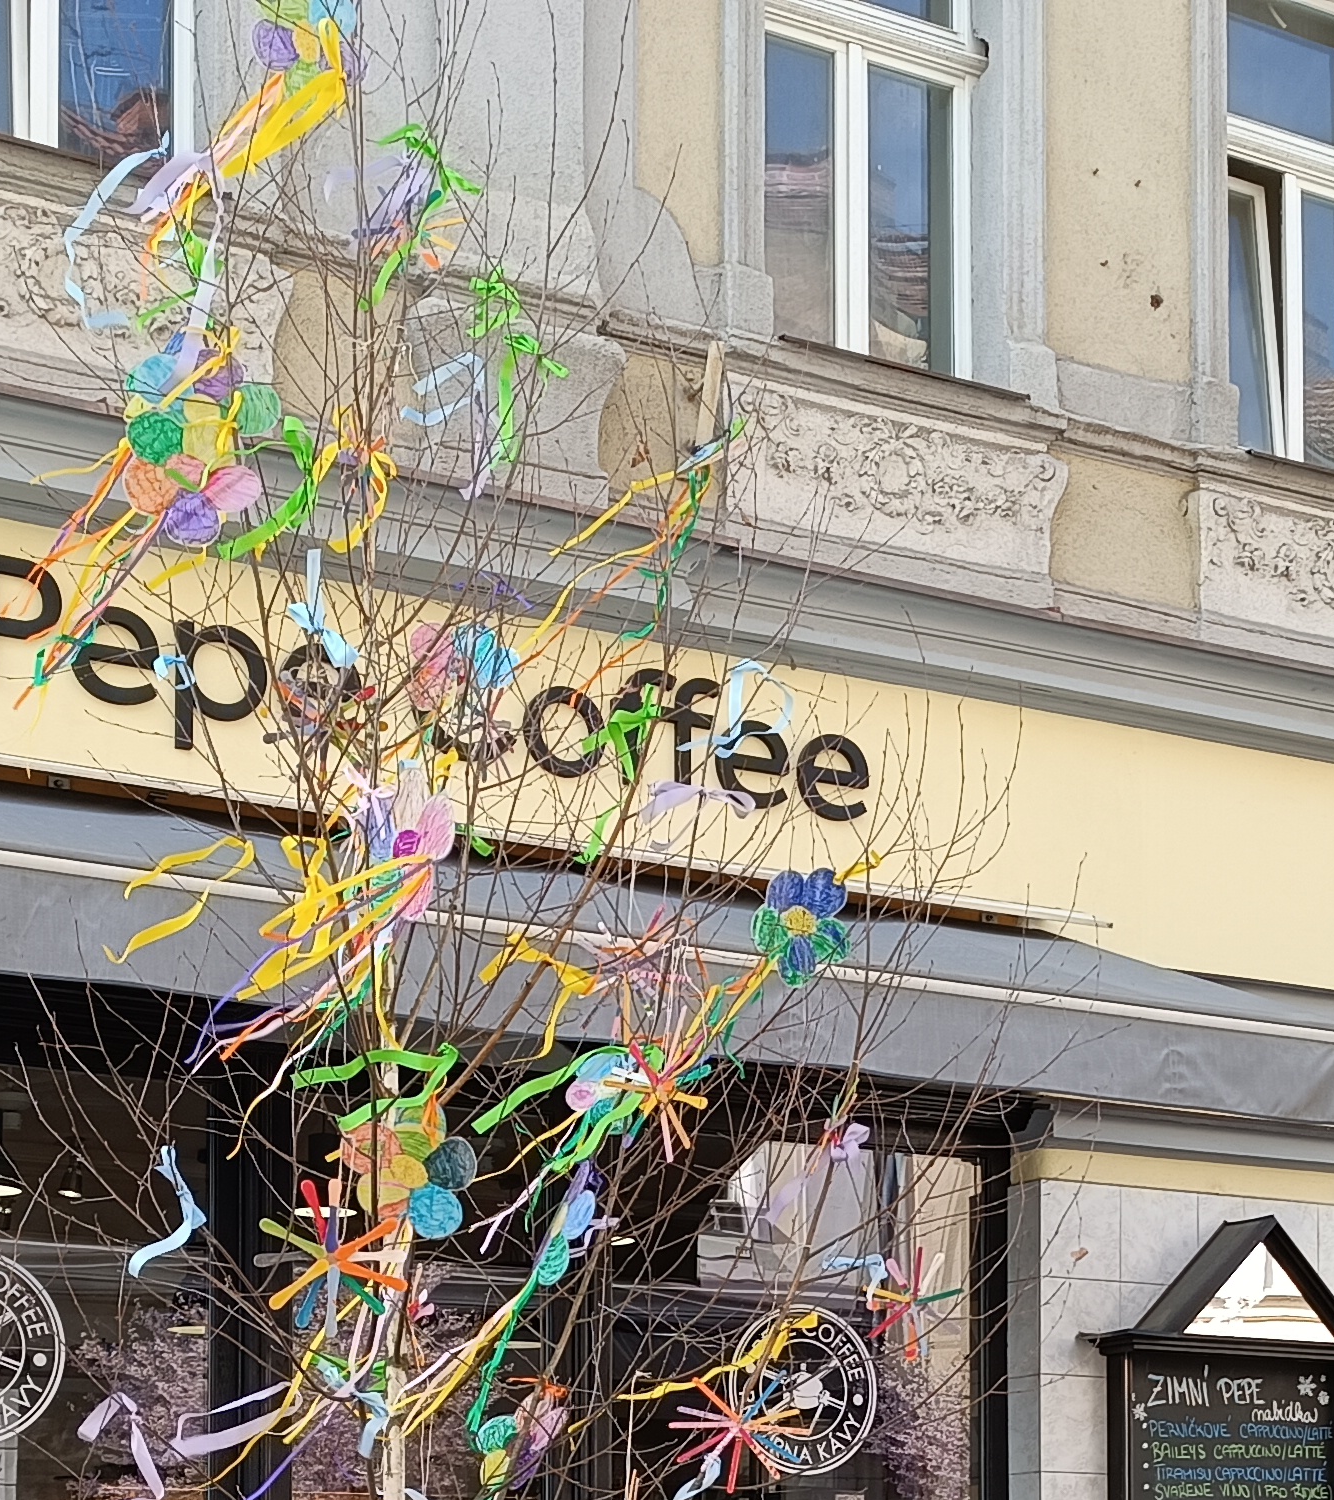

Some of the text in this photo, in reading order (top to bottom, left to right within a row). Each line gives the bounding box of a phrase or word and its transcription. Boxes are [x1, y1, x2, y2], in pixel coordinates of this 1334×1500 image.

[1146, 1364, 1266, 1408] ZIMNÍ PEPE
[1251, 1399, 1319, 1424] nabídka
[816, 1412, 861, 1462] KÁVY
[1151, 1441, 1207, 1462] BAILEYS
[1263, 1485, 1288, 1500] PRO
